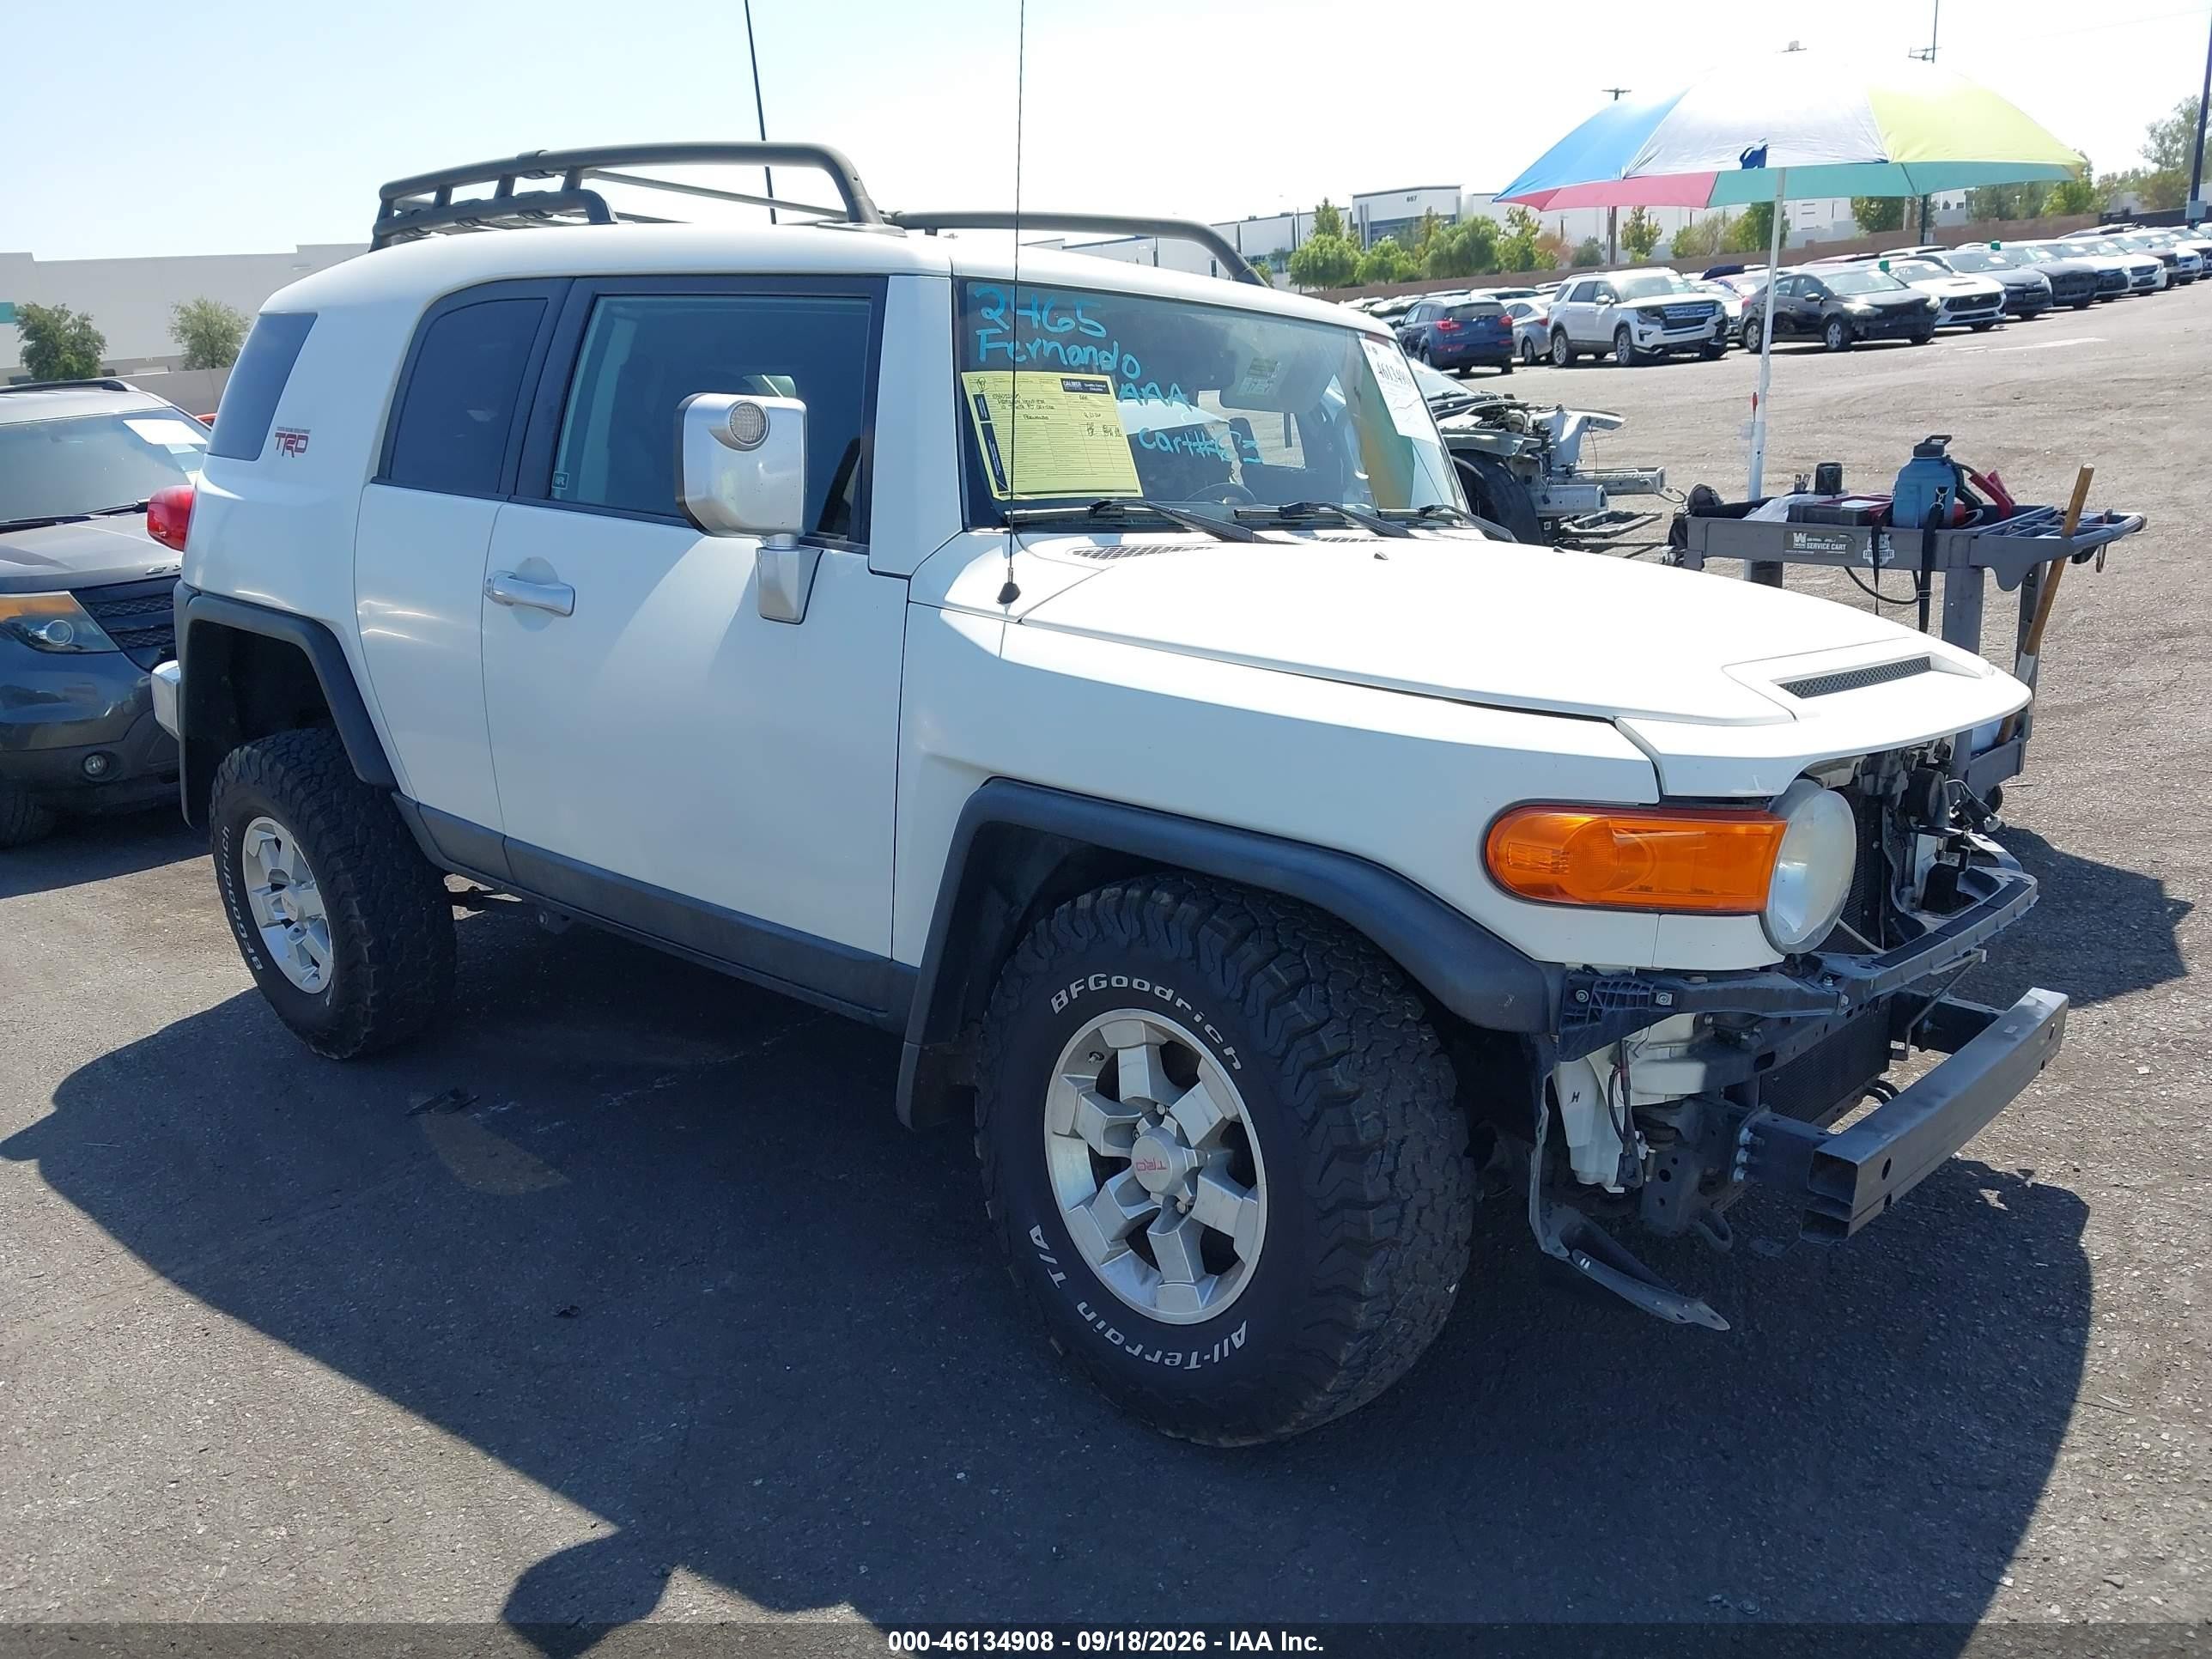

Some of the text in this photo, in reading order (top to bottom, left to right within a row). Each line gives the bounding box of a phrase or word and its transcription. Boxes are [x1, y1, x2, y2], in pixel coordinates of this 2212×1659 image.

[974, 285, 1107, 337] 2465
[975, 328, 1141, 380] Fernando
[275, 432, 309, 458] TRD
[222, 825, 263, 970] BFGoodrich
[1050, 973, 1242, 1070] BFGoodrich
[1135, 1157, 1169, 1171] TRD
[1029, 1224, 1248, 1370] All-Terrain T/A
